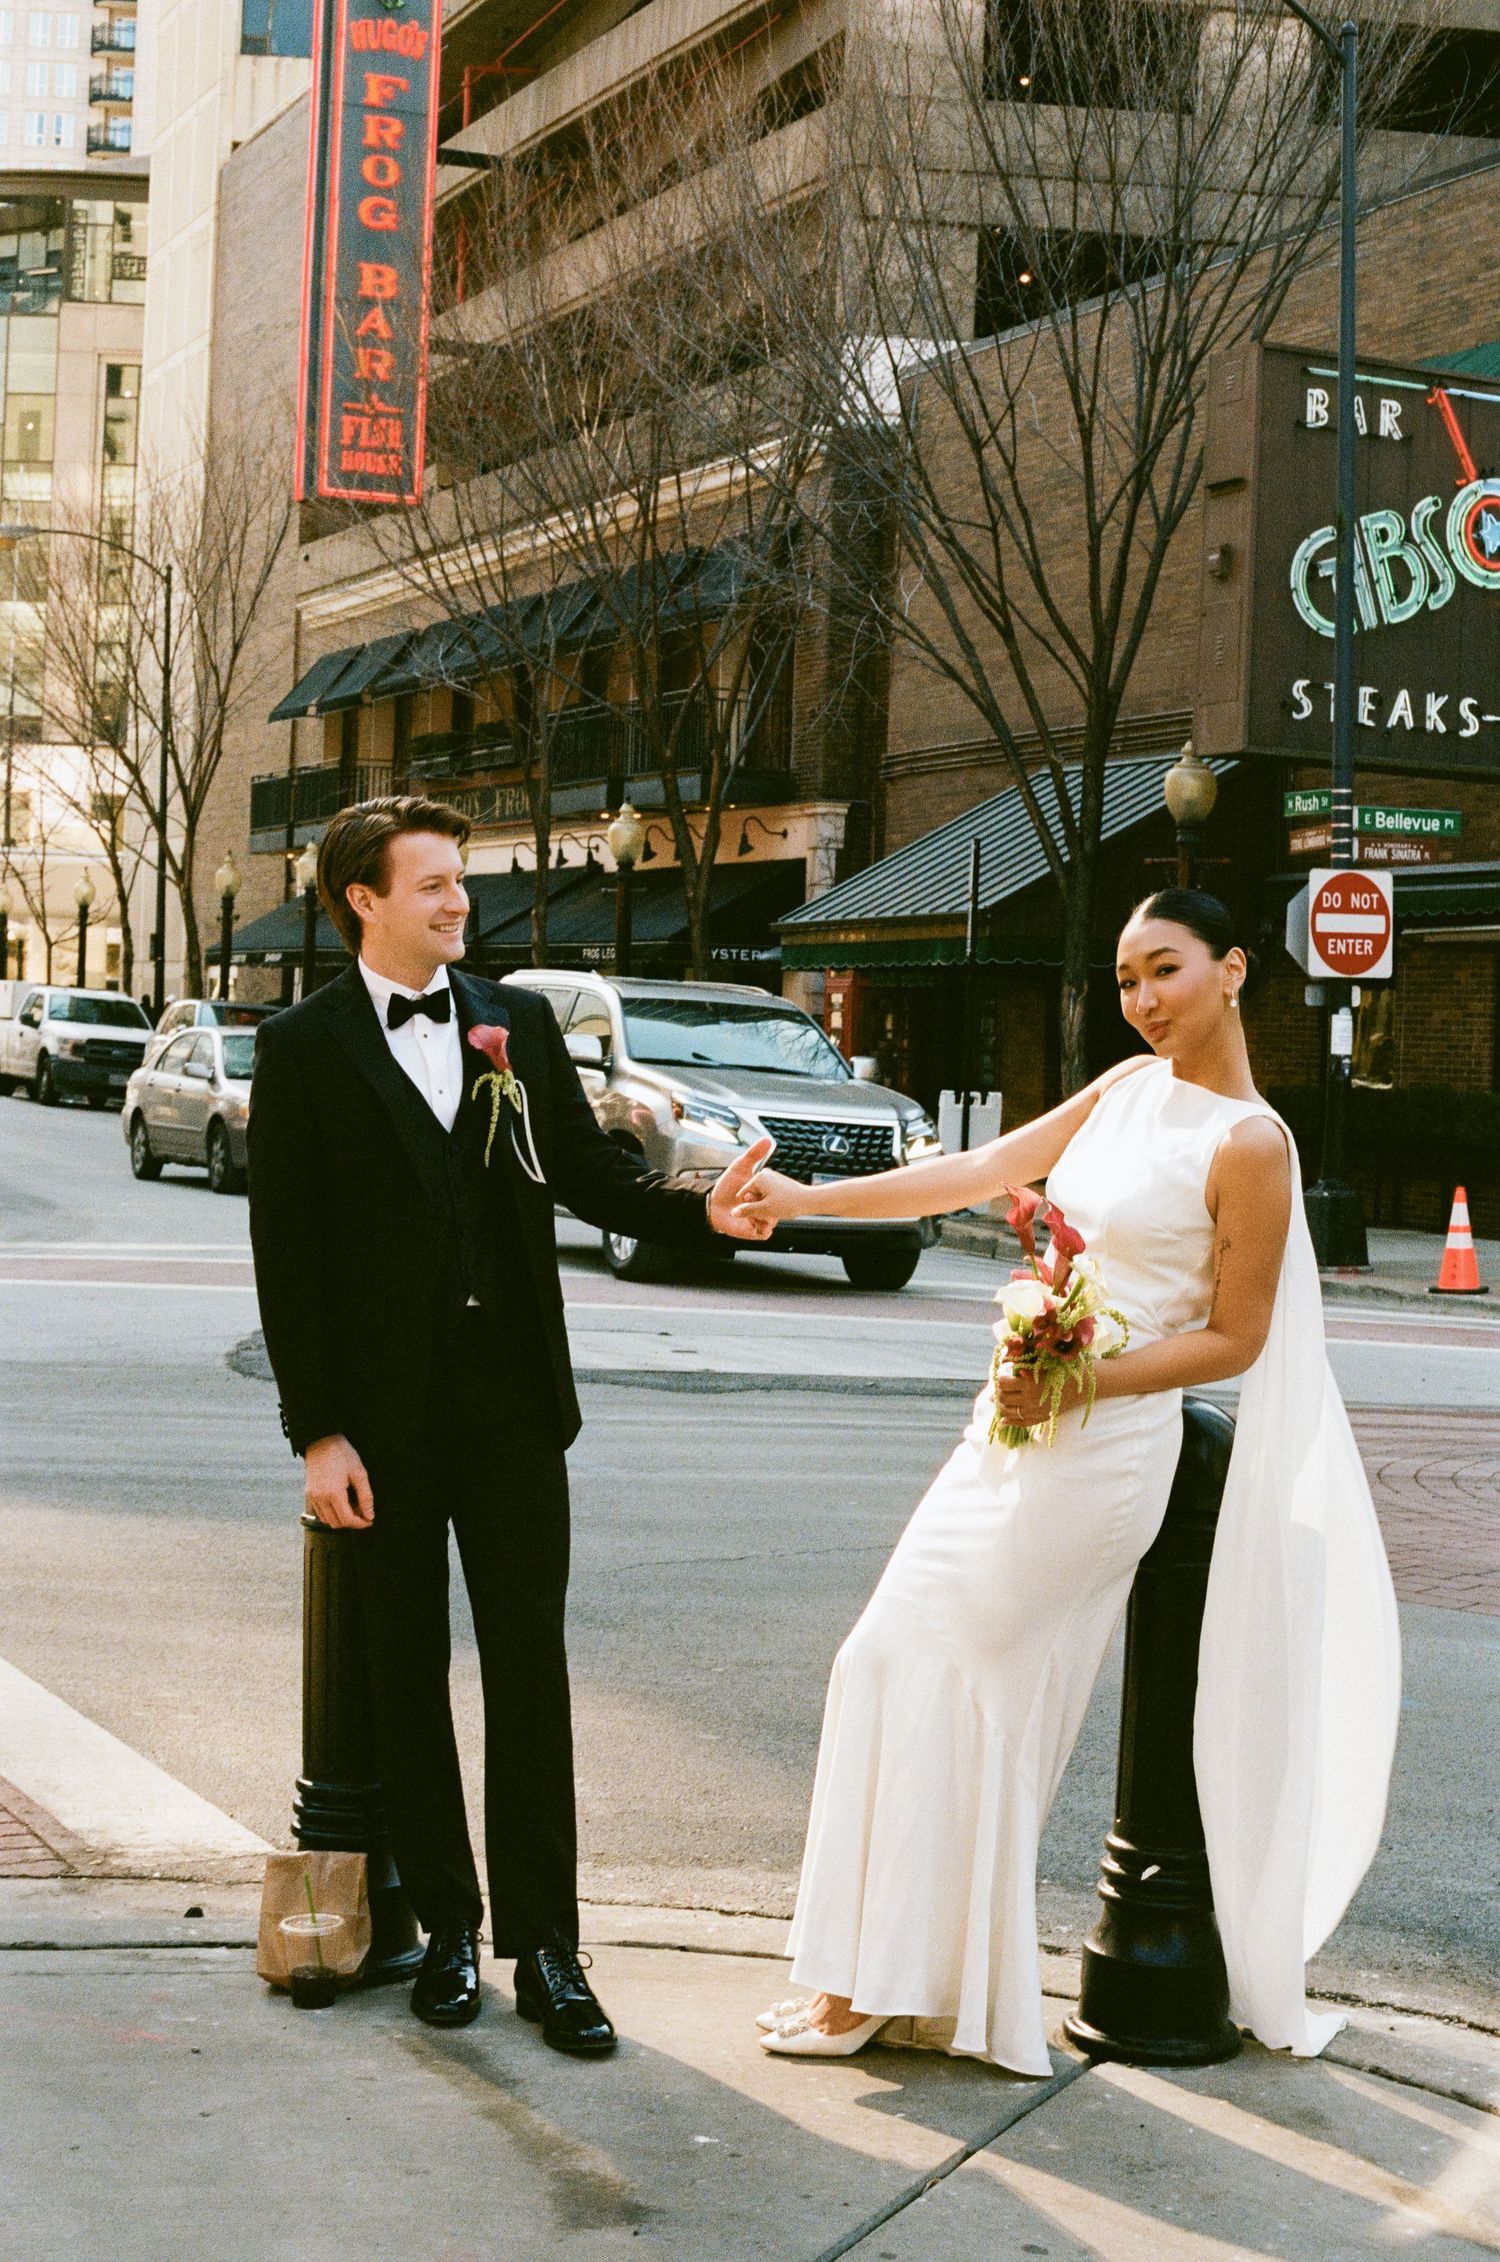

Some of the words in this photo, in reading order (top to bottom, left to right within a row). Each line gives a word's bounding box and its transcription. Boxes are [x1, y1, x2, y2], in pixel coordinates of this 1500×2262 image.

[357, 72, 409, 232] FROG
[354, 261, 398, 382] BAR
[1295, 794, 1320, 812] Rush
[1364, 813, 1371, 824] E
[1375, 811, 1440, 831] Bellevue
[1364, 847, 1389, 860] FRANK
[1391, 849, 1421, 861] SINATRA
[1322, 891, 1342, 909] DO
[1350, 892, 1379, 910] NOT
[1327, 938, 1373, 956] ENTER
